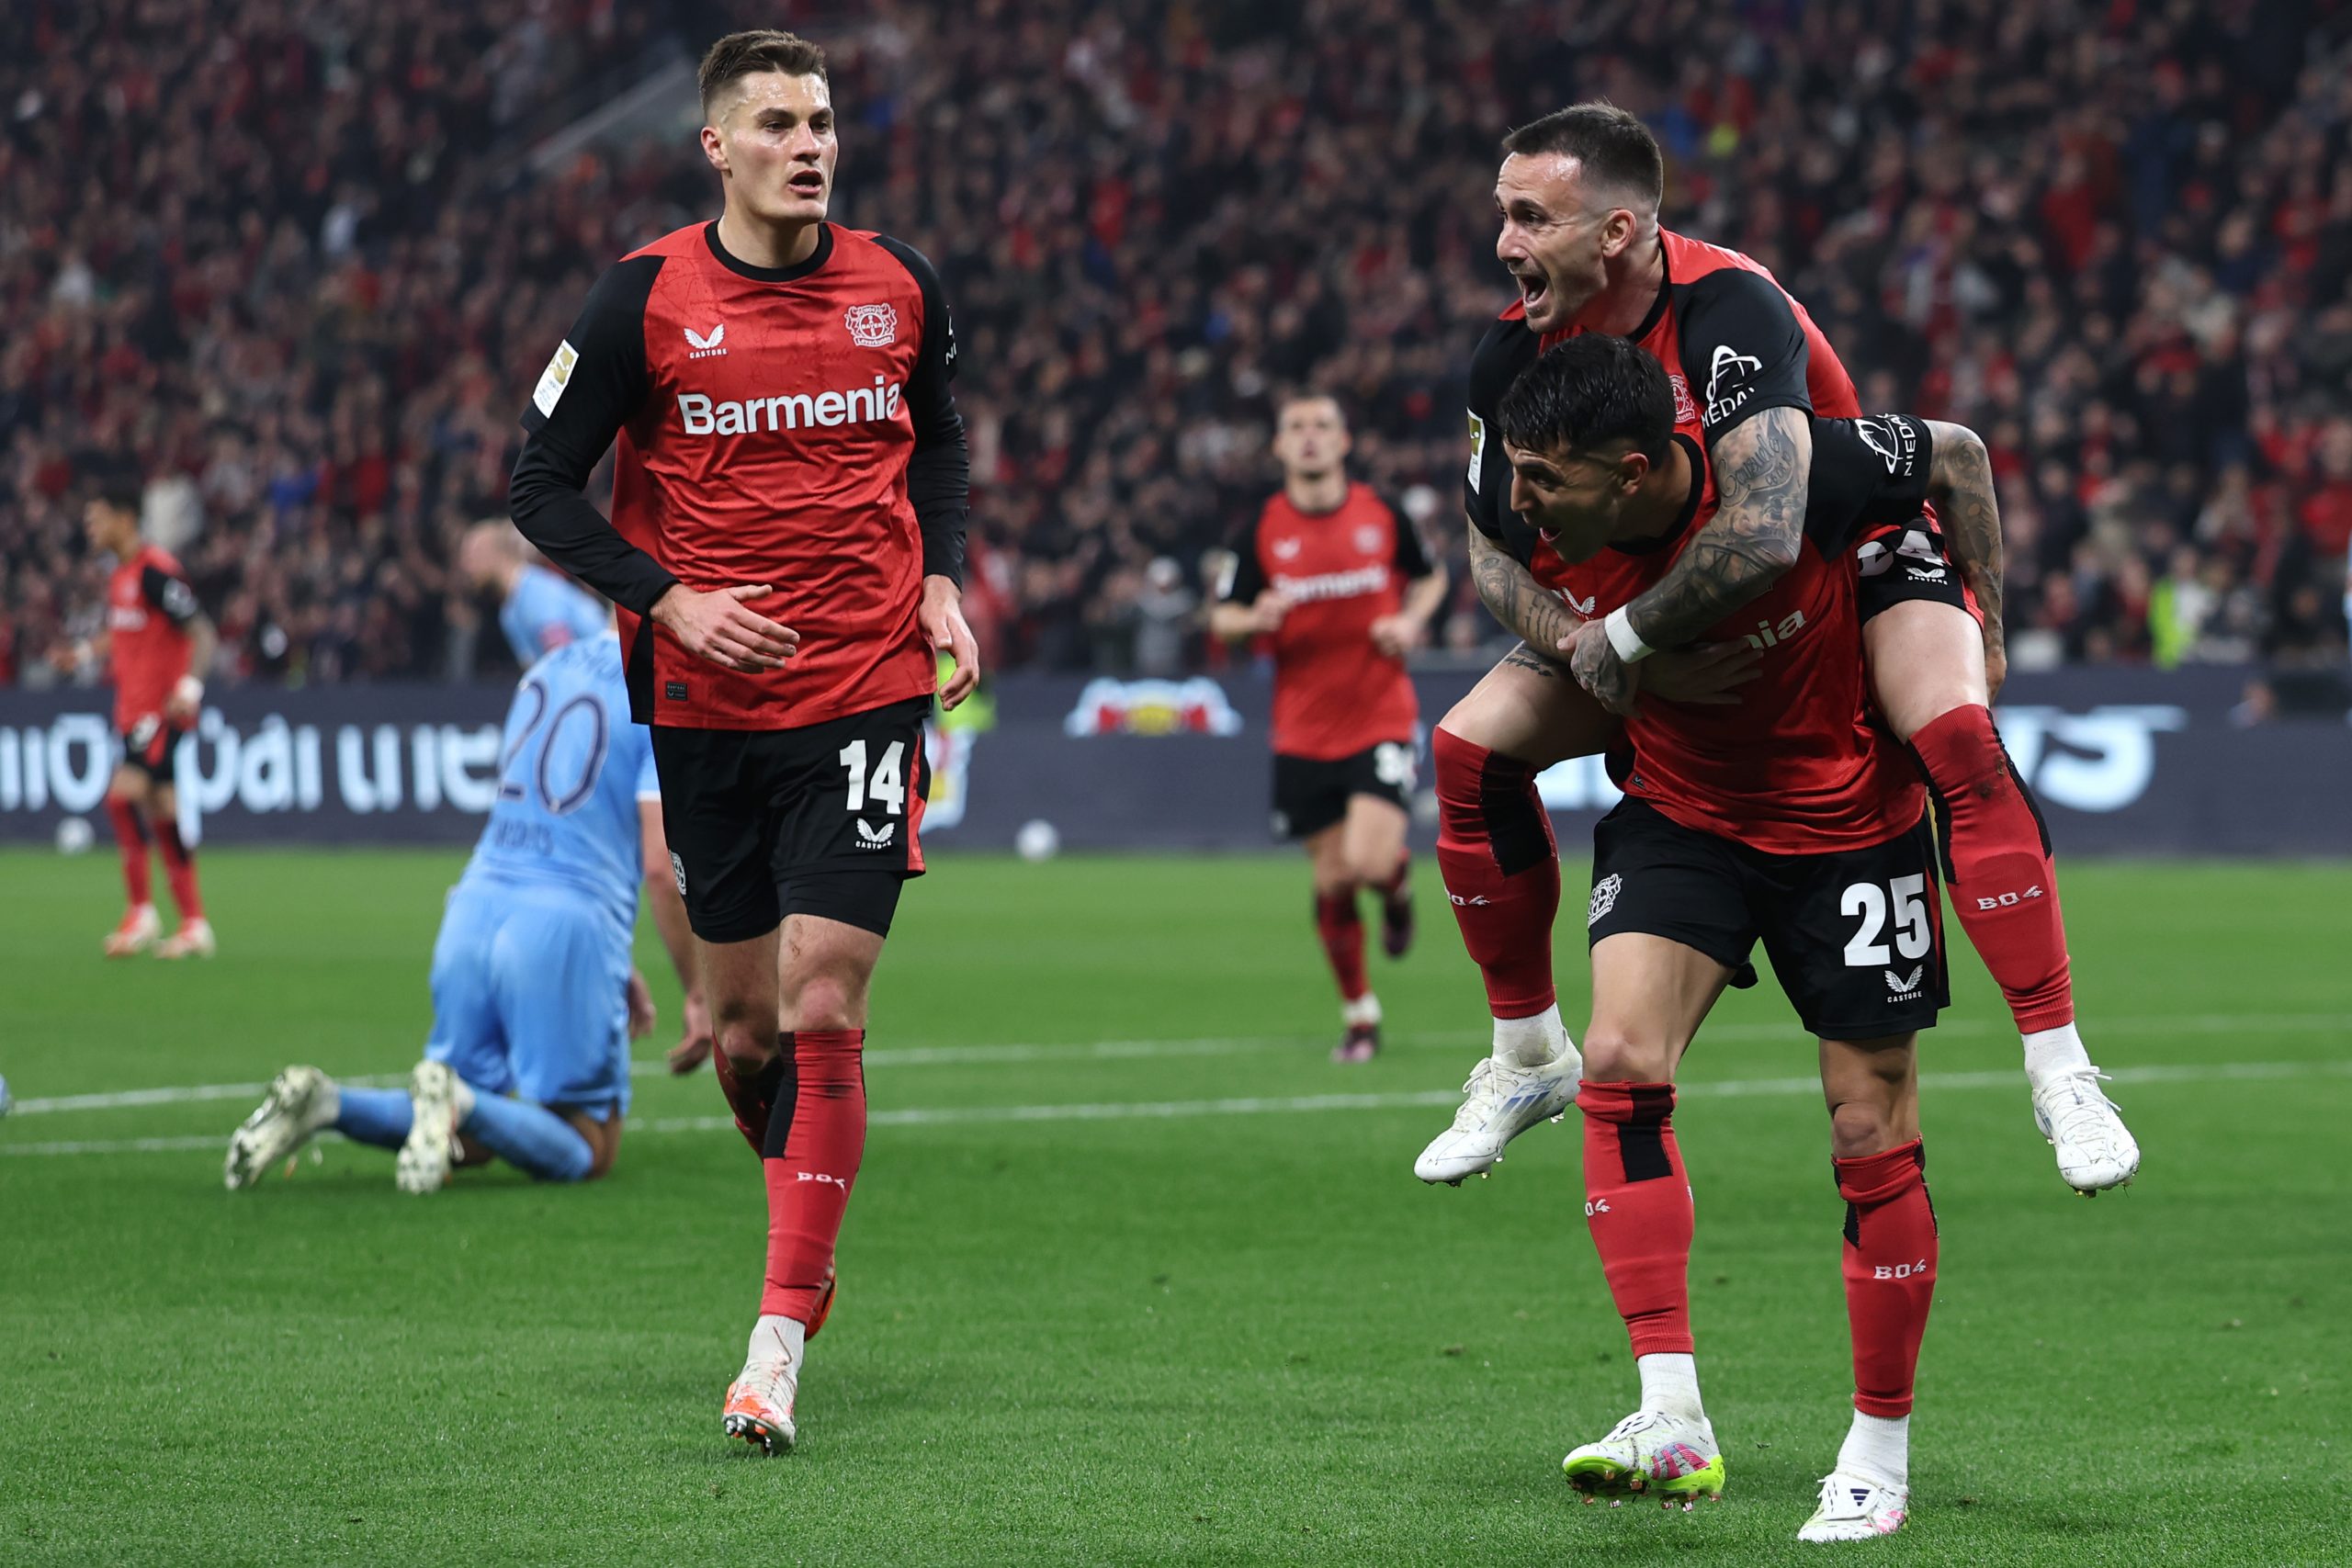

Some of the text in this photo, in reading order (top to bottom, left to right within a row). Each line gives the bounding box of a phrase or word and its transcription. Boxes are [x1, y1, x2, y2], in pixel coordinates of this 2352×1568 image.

[689, 348, 728, 360] CASTORE
[677, 375, 900, 436] Barmenia
[1892, 414, 1917, 477] NIEDA
[499, 678, 609, 817] 20
[839, 739, 905, 815] 14
[1840, 873, 1931, 966] 25
[1887, 990, 1923, 1003] CASTORE
